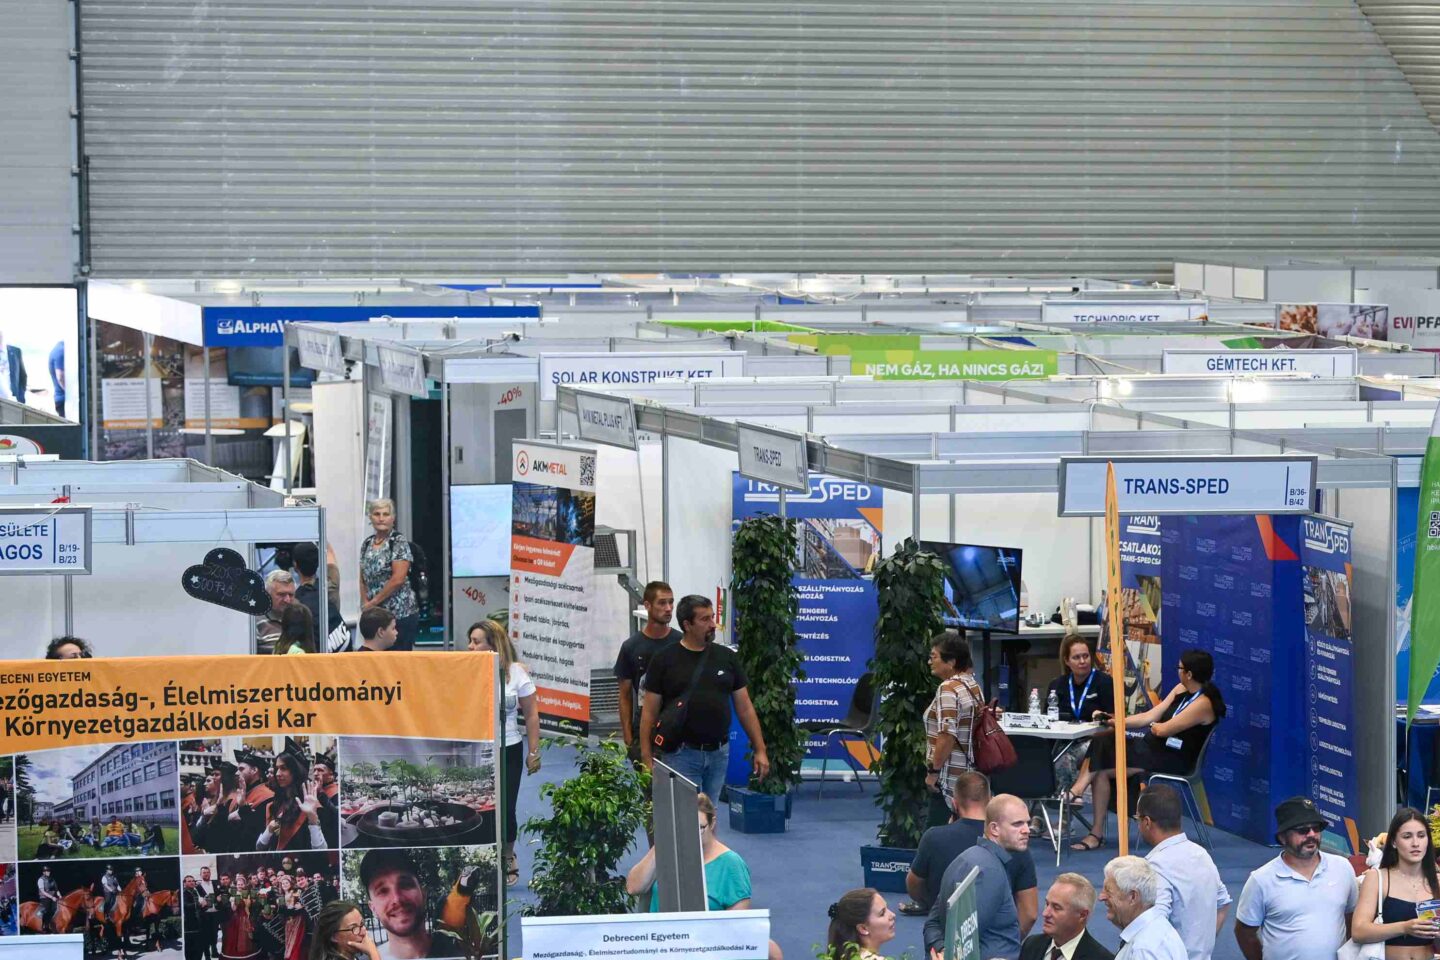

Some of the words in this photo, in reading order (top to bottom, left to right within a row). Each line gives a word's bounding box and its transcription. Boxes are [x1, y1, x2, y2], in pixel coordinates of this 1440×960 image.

[865, 364, 898, 376] NEM
[901, 361, 935, 377] GÁZ,
[939, 364, 959, 376] HA
[963, 364, 1007, 376] NINCS
[1010, 361, 1044, 376] GÁZ!
[1207, 355, 1268, 371] GÉMTECH
[1272, 358, 1296, 371] KFT.
[552, 371, 597, 384] SOLAR
[753, 446, 782, 467] TRANS-SPED
[1124, 478, 1229, 494] TRANS-SPED
[1290, 488, 1307, 496] B/36-
[1289, 498, 1304, 506] B/42
[59, 544, 80, 553] B/19-
[59, 556, 77, 564] B/23
[798, 584, 864, 593] SZÁLLÍTMÁNYOZÁS
[38, 671, 91, 683] EGYETEM
[163, 680, 402, 708] Élelmiszertudományi
[5, 708, 270, 740] Környezetgazdálkodási
[278, 708, 317, 729] Kar
[603, 933, 648, 943] Debreceni
[650, 932, 690, 943] Egyetem
[588, 947, 659, 957] Élelmiszertudományi
[669, 944, 744, 956] Környezetgazdálkodási
